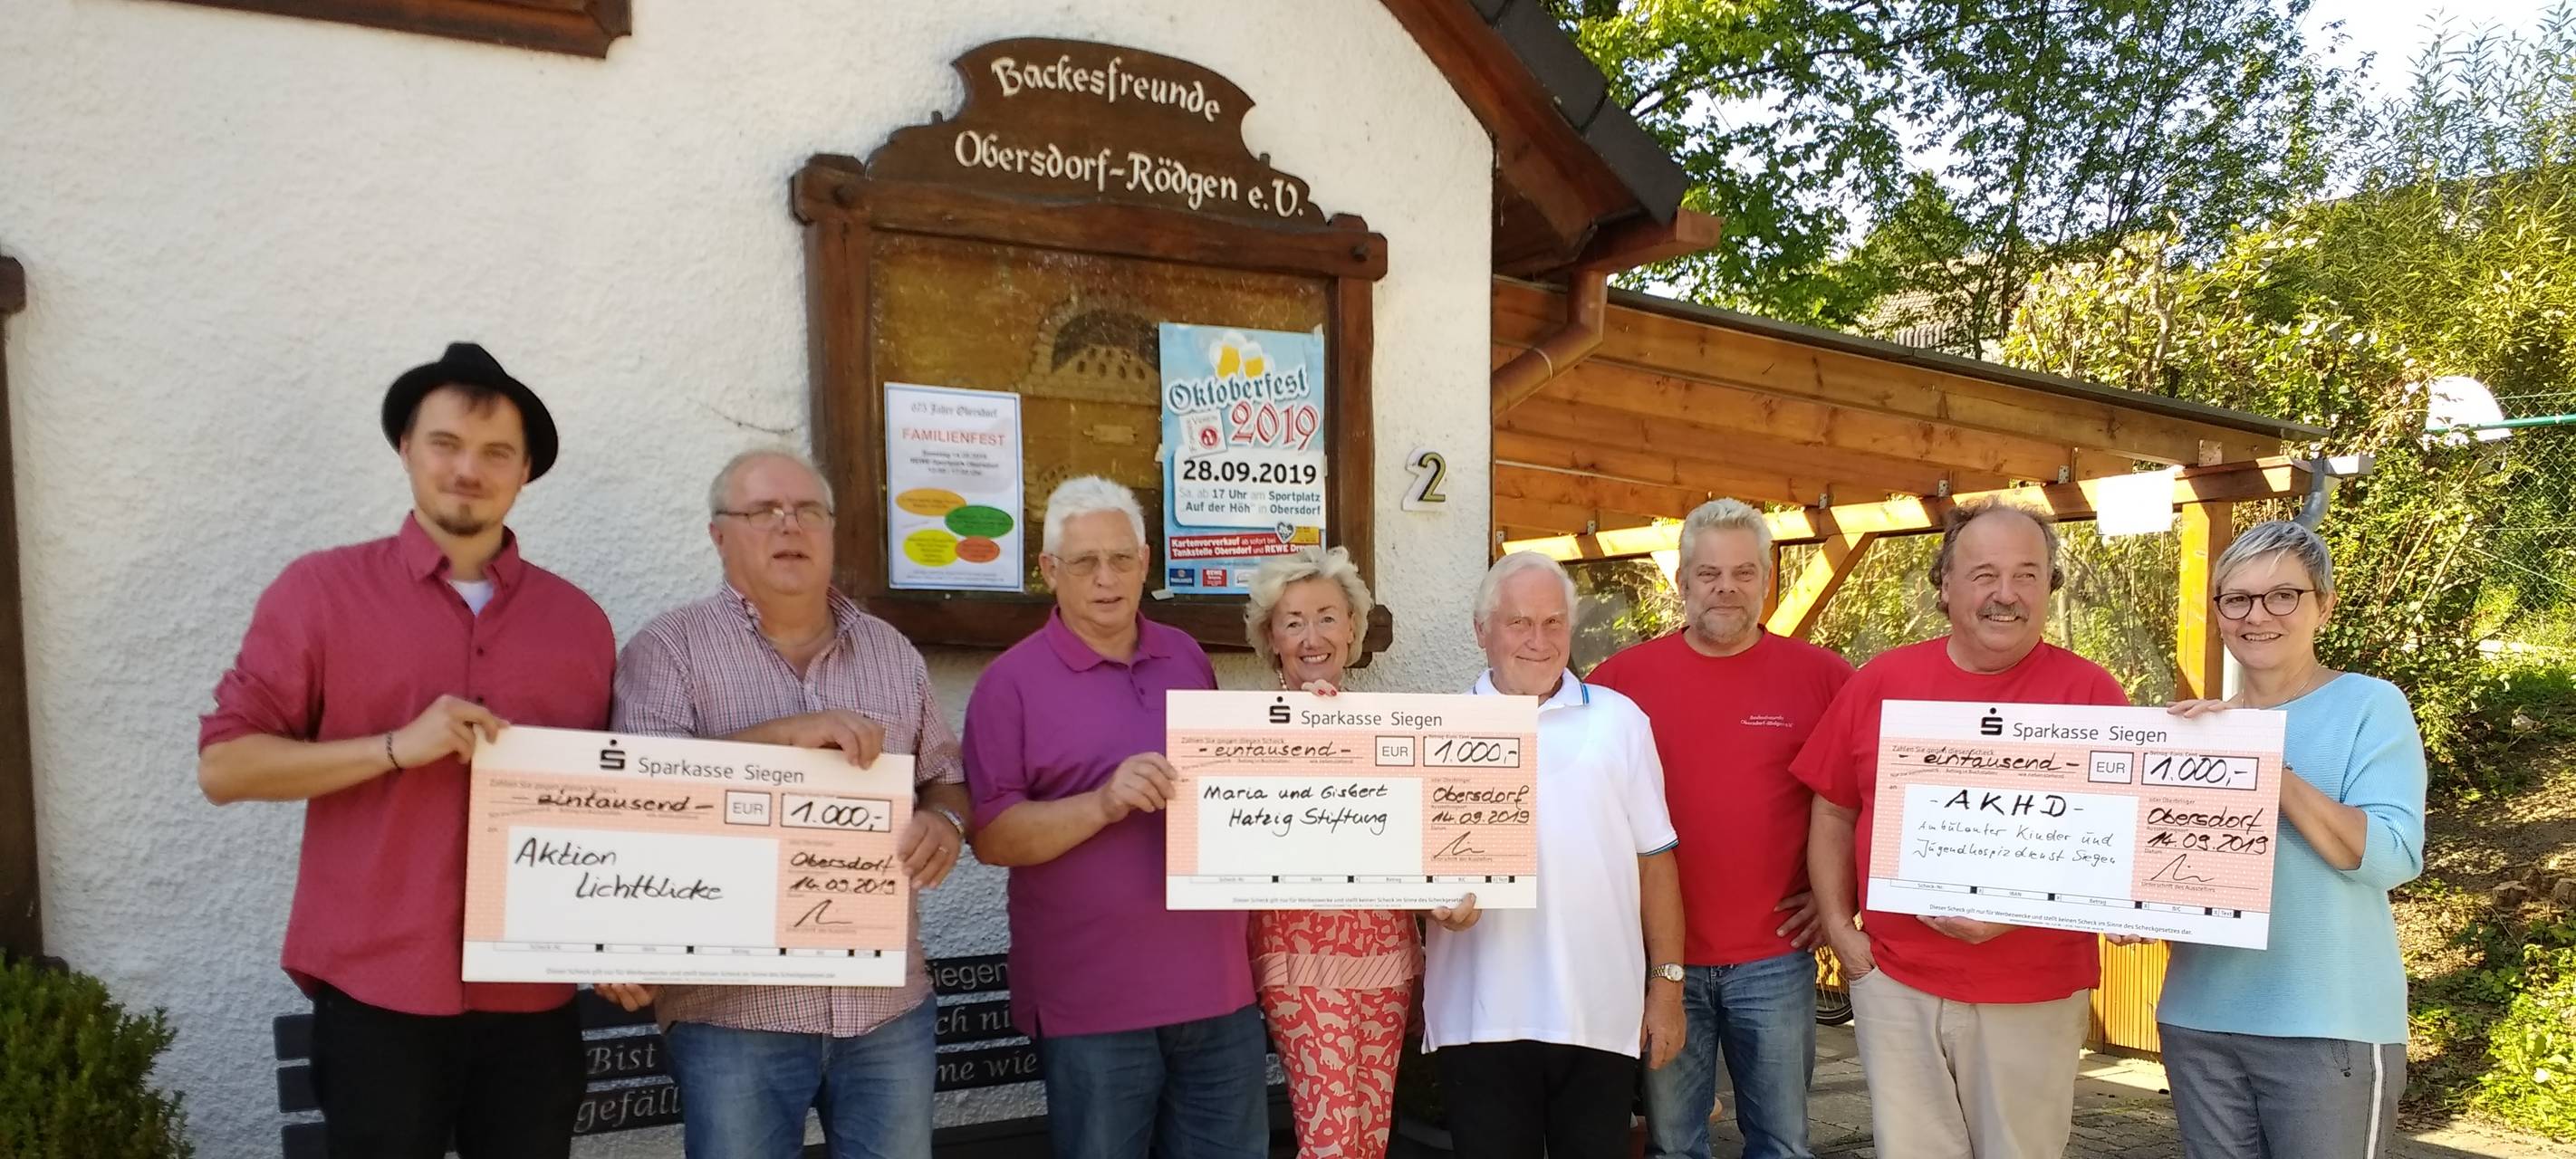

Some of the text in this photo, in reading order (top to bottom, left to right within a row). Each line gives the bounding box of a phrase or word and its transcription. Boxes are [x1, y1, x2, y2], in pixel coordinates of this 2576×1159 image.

[992, 56, 1220, 121] Backesfreunde
[955, 130, 1237, 210] Obersdorf-Rödgen
[1169, 368, 1306, 410] Oktoberfest
[902, 428, 1005, 445] FAMILIENFEST
[1232, 401, 1319, 450] 2019
[1183, 460, 1317, 484] 28.09.2019
[1413, 451, 1447, 504] 2
[1212, 489, 1225, 498] 17
[1229, 490, 1247, 499] Uhr
[1269, 491, 1321, 503] Sportplatz
[1208, 503, 1225, 512] der
[1270, 504, 1321, 515] Obersdorf
[1301, 710, 1382, 730] Sparkasse
[1391, 712, 1443, 730] Siegen
[2013, 723, 2100, 743] Sparkasse
[2109, 725, 2167, 746] Siegen
[1382, 746, 1408, 757] EUR
[638, 757, 734, 781] Sparkasse
[745, 764, 804, 786] Siegen
[2097, 761, 2126, 775] EUR
[1204, 784, 1389, 800] Maria und Gisbert
[1433, 785, 1529, 809] Obersdorf
[732, 800, 764, 816] EUR
[1432, 810, 1530, 825] 14.09.2019
[1228, 808, 1388, 838] Hatzig Stiftung
[2148, 806, 2264, 835] Obersdorf
[2015, 824, 2071, 842] Kinder
[2148, 831, 2269, 855] 14.09.2019
[514, 837, 617, 867] Aktion
[791, 852, 894, 874] Obersdorf
[576, 872, 725, 899] Lichtblicke
[587, 1043, 656, 1075] Bist
[573, 1087, 681, 1134] gefäll
